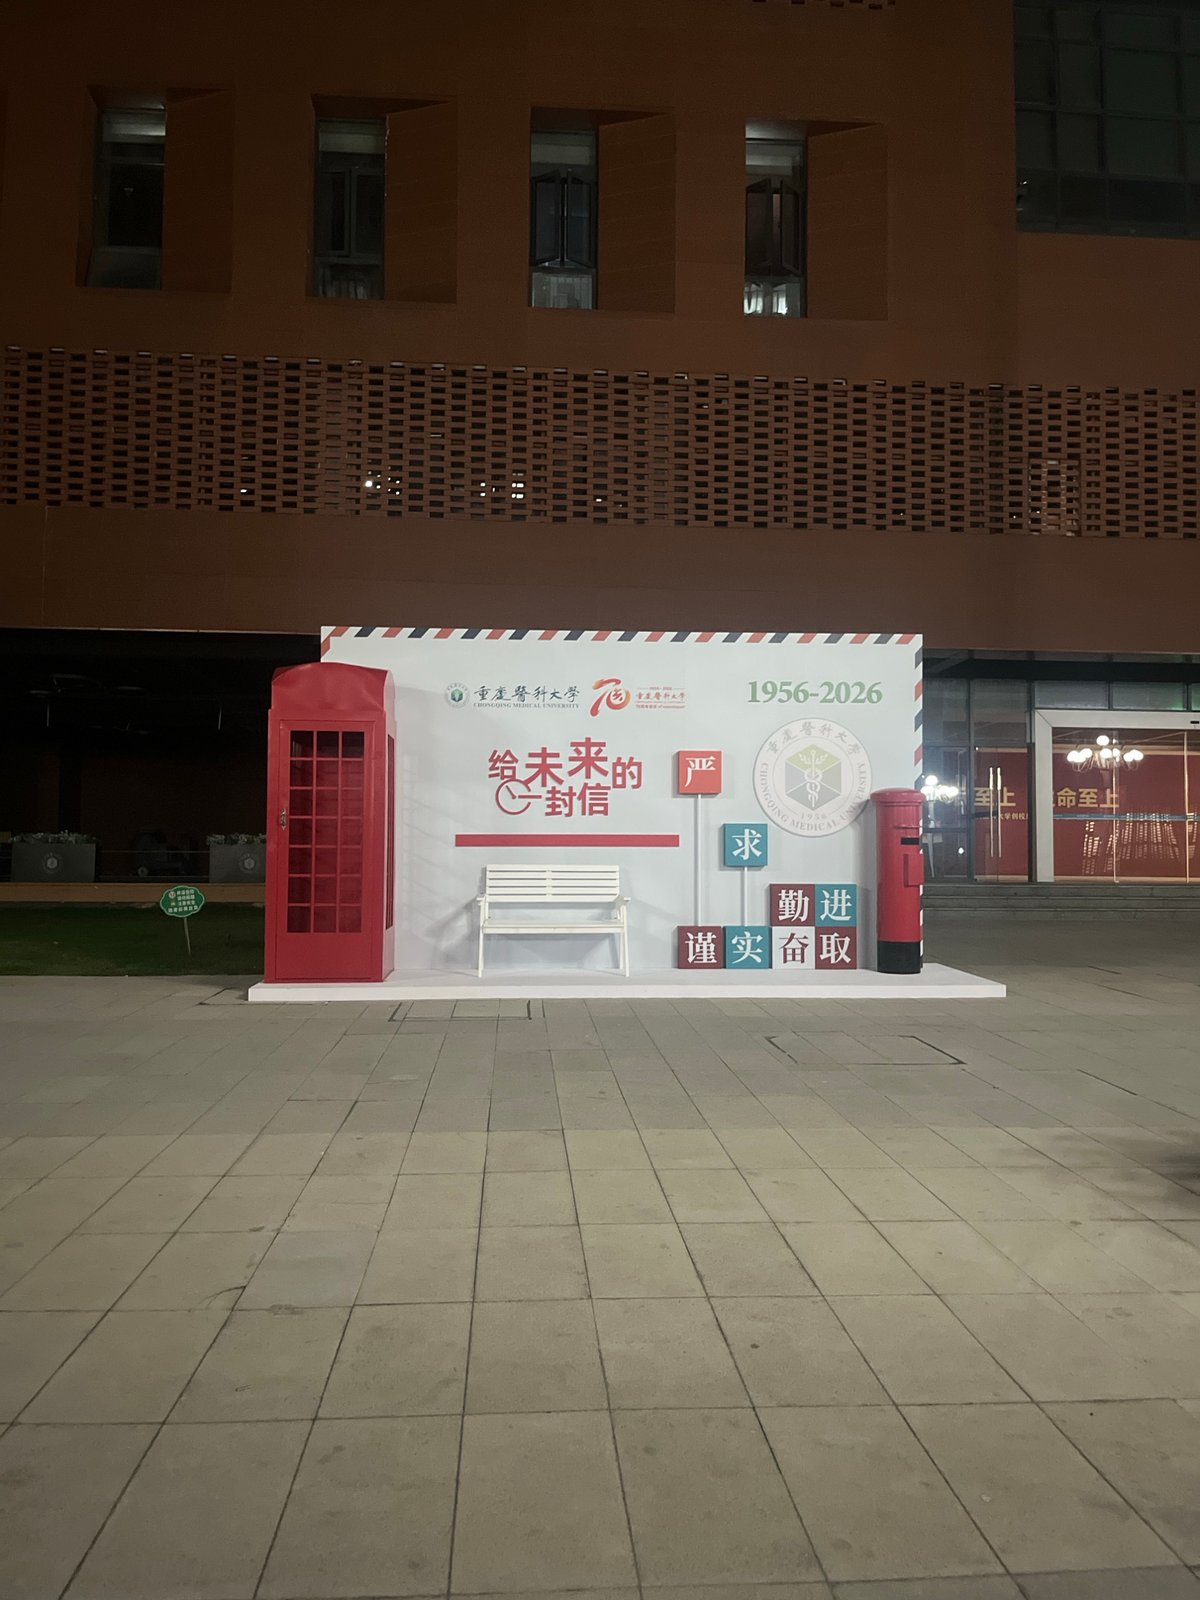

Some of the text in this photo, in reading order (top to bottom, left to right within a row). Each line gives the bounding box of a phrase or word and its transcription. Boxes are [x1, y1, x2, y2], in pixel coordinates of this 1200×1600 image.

[748, 681, 883, 704] 1956-2026
[488, 737, 642, 789] 给未来的
[1053, 788, 1119, 808] 命至上
[789, 814, 839, 832] MEDICAL
